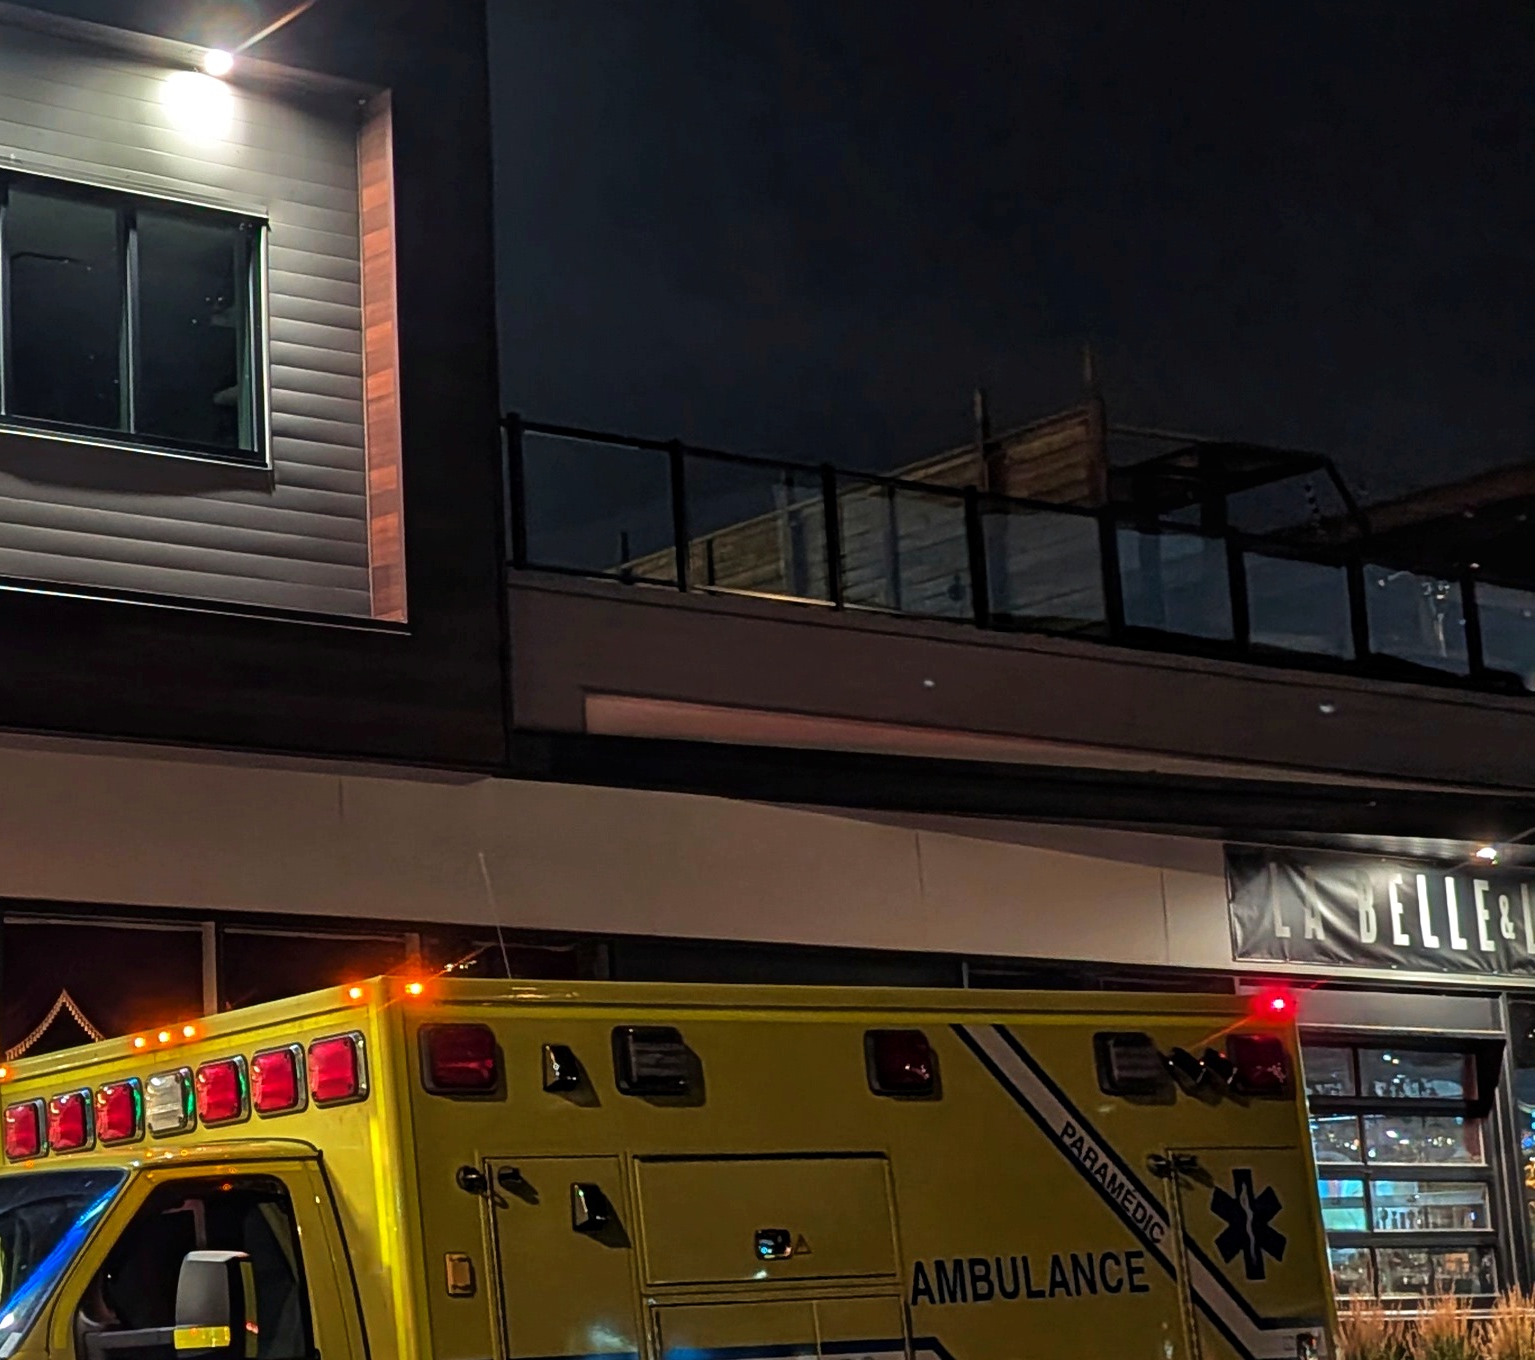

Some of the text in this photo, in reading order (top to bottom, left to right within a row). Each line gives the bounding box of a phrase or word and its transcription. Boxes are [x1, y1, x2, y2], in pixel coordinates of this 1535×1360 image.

[1269, 862, 1326, 941] LA
[1355, 869, 1496, 952] BELLE
[1498, 894, 1516, 940] &
[911, 1250, 1150, 1306] AMBULANCE
